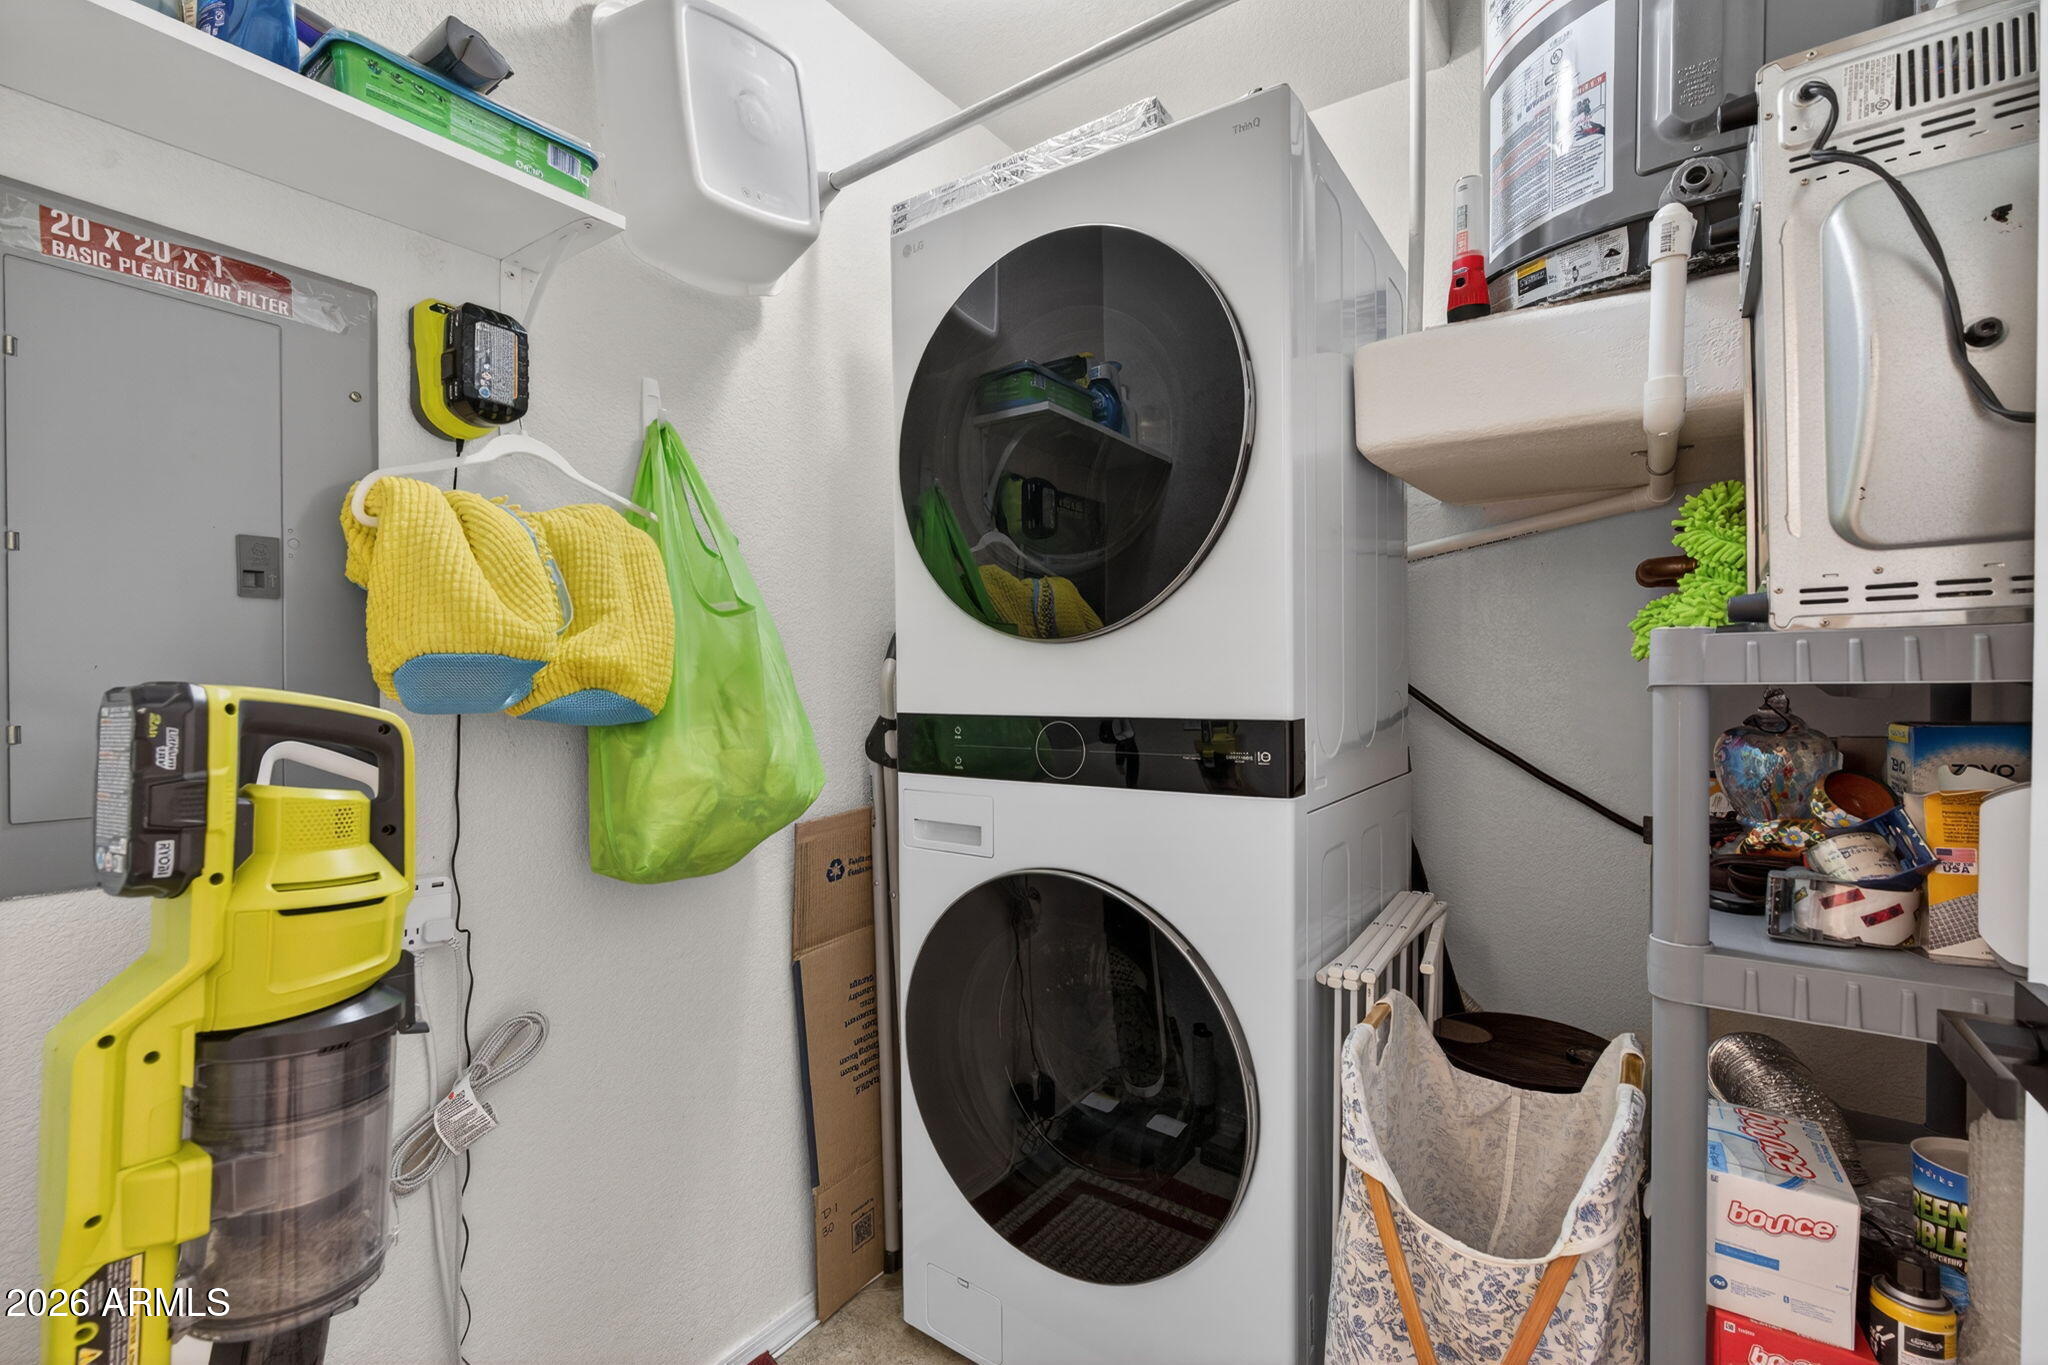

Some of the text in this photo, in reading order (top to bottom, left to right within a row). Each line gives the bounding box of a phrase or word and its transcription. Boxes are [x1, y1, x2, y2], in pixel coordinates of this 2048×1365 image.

[1232, 116, 1261, 135] ThinQ
[50, 208, 91, 242] 20
[134, 233, 170, 263] 20
[211, 254, 223, 278] 1
[912, 241, 924, 254] LG
[52, 239, 289, 316] BASIC PLEATED AIR FILTER
[157, 843, 171, 876] RYOBI
[1942, 864, 1971, 874] USA
[1733, 1107, 1816, 1179] bounce
[1727, 1200, 1836, 1241] bounce
